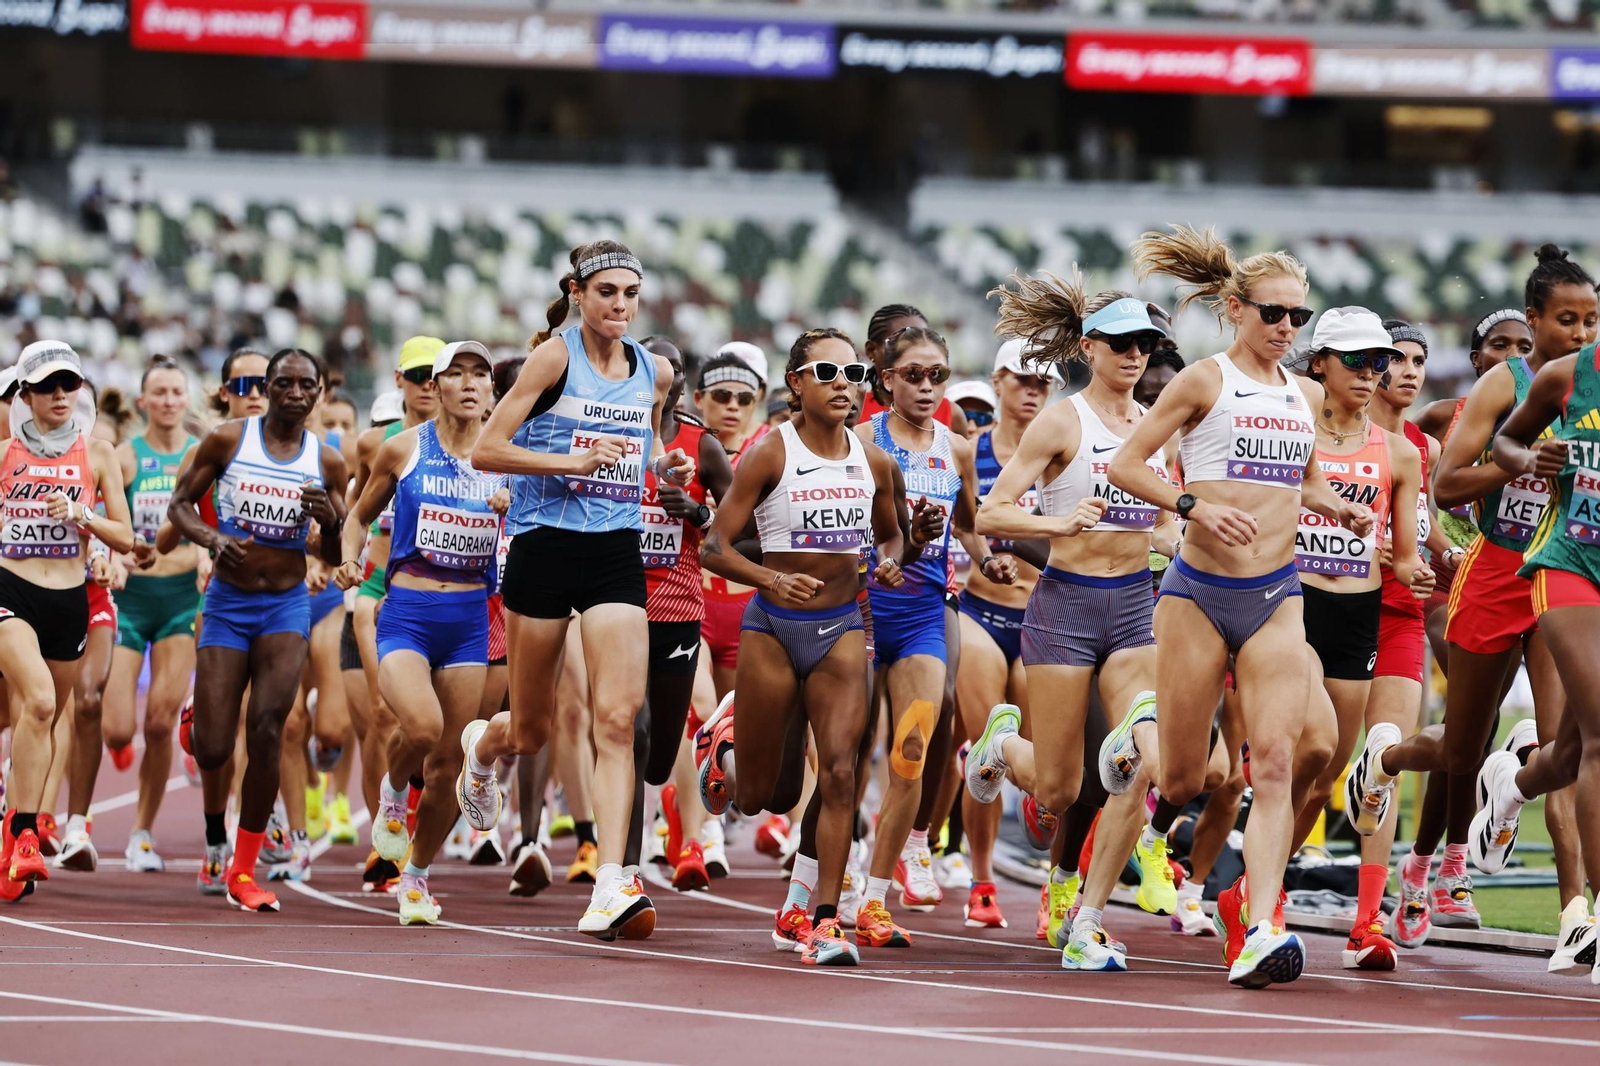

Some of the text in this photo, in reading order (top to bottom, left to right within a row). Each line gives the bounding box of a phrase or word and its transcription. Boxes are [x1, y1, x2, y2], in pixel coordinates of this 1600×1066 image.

[583, 404, 645, 424] URUGUAY
[1233, 416, 1314, 434] HONDA
[573, 435, 642, 455] HDA
[1234, 437, 1311, 462] SULLIVAN
[239, 481, 301, 500] HOND
[905, 472, 950, 497] GOLIA
[1330, 481, 1379, 505] PAN
[790, 487, 870, 503] HONDA
[5, 507, 54, 519] HON
[421, 508, 497, 529] HONDA
[802, 507, 865, 529] KEMP
[1504, 497, 1546, 523] KET
[11, 524, 67, 541] SATO
[420, 528, 494, 553] GALBADRAKH
[639, 532, 676, 551] MBA
[1295, 532, 1366, 557] ANDO
